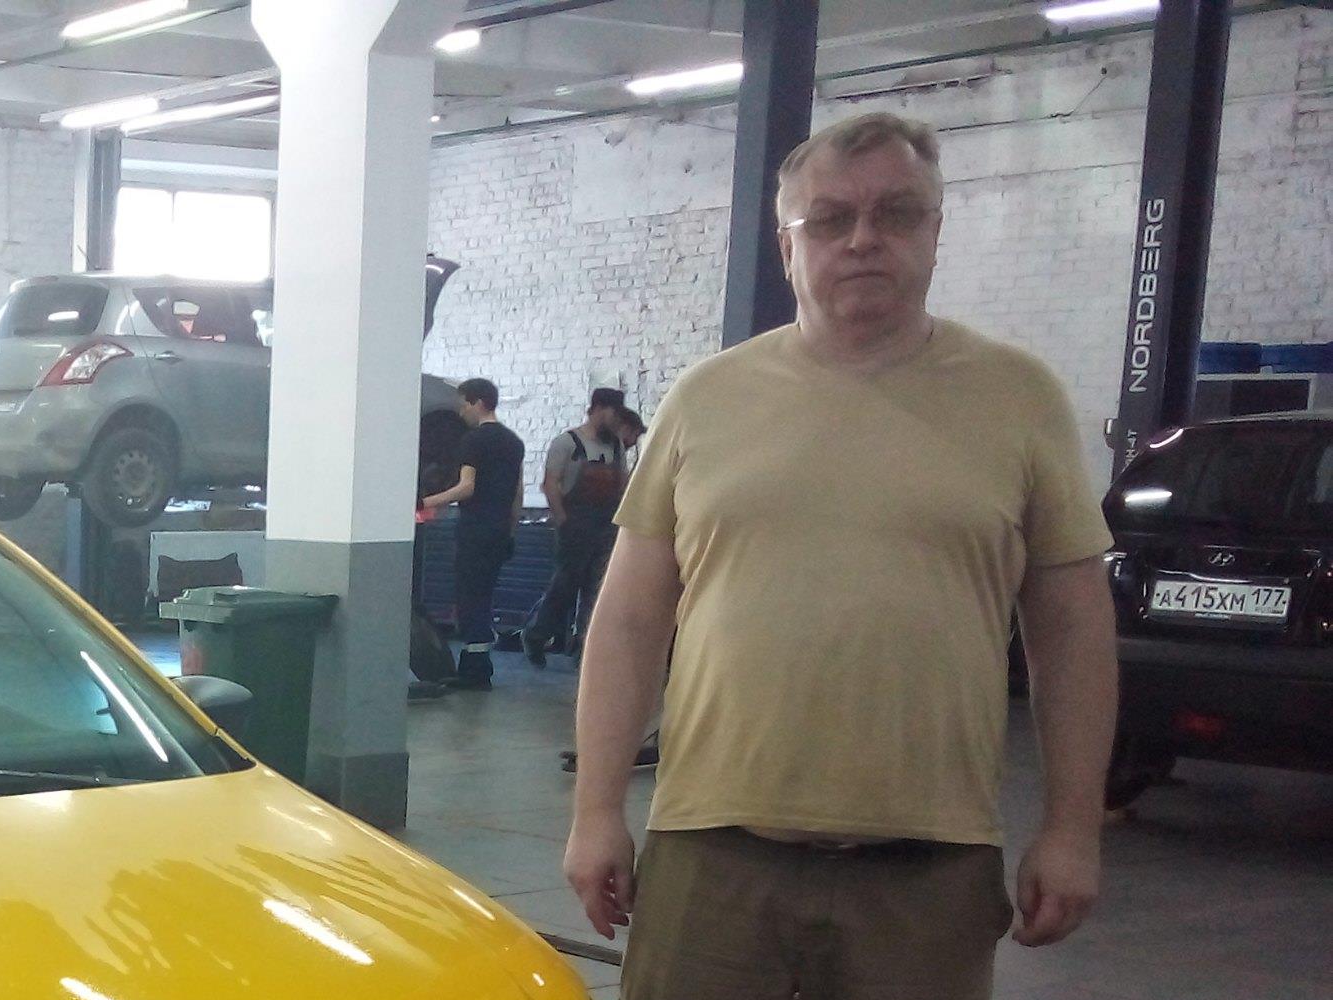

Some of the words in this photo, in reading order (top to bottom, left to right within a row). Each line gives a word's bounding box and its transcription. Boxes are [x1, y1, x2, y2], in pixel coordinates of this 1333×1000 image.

[1128, 198, 1165, 393] NORDBERG
[1158, 585, 1246, 612] А415ХМ
[1252, 588, 1285, 607] 177
